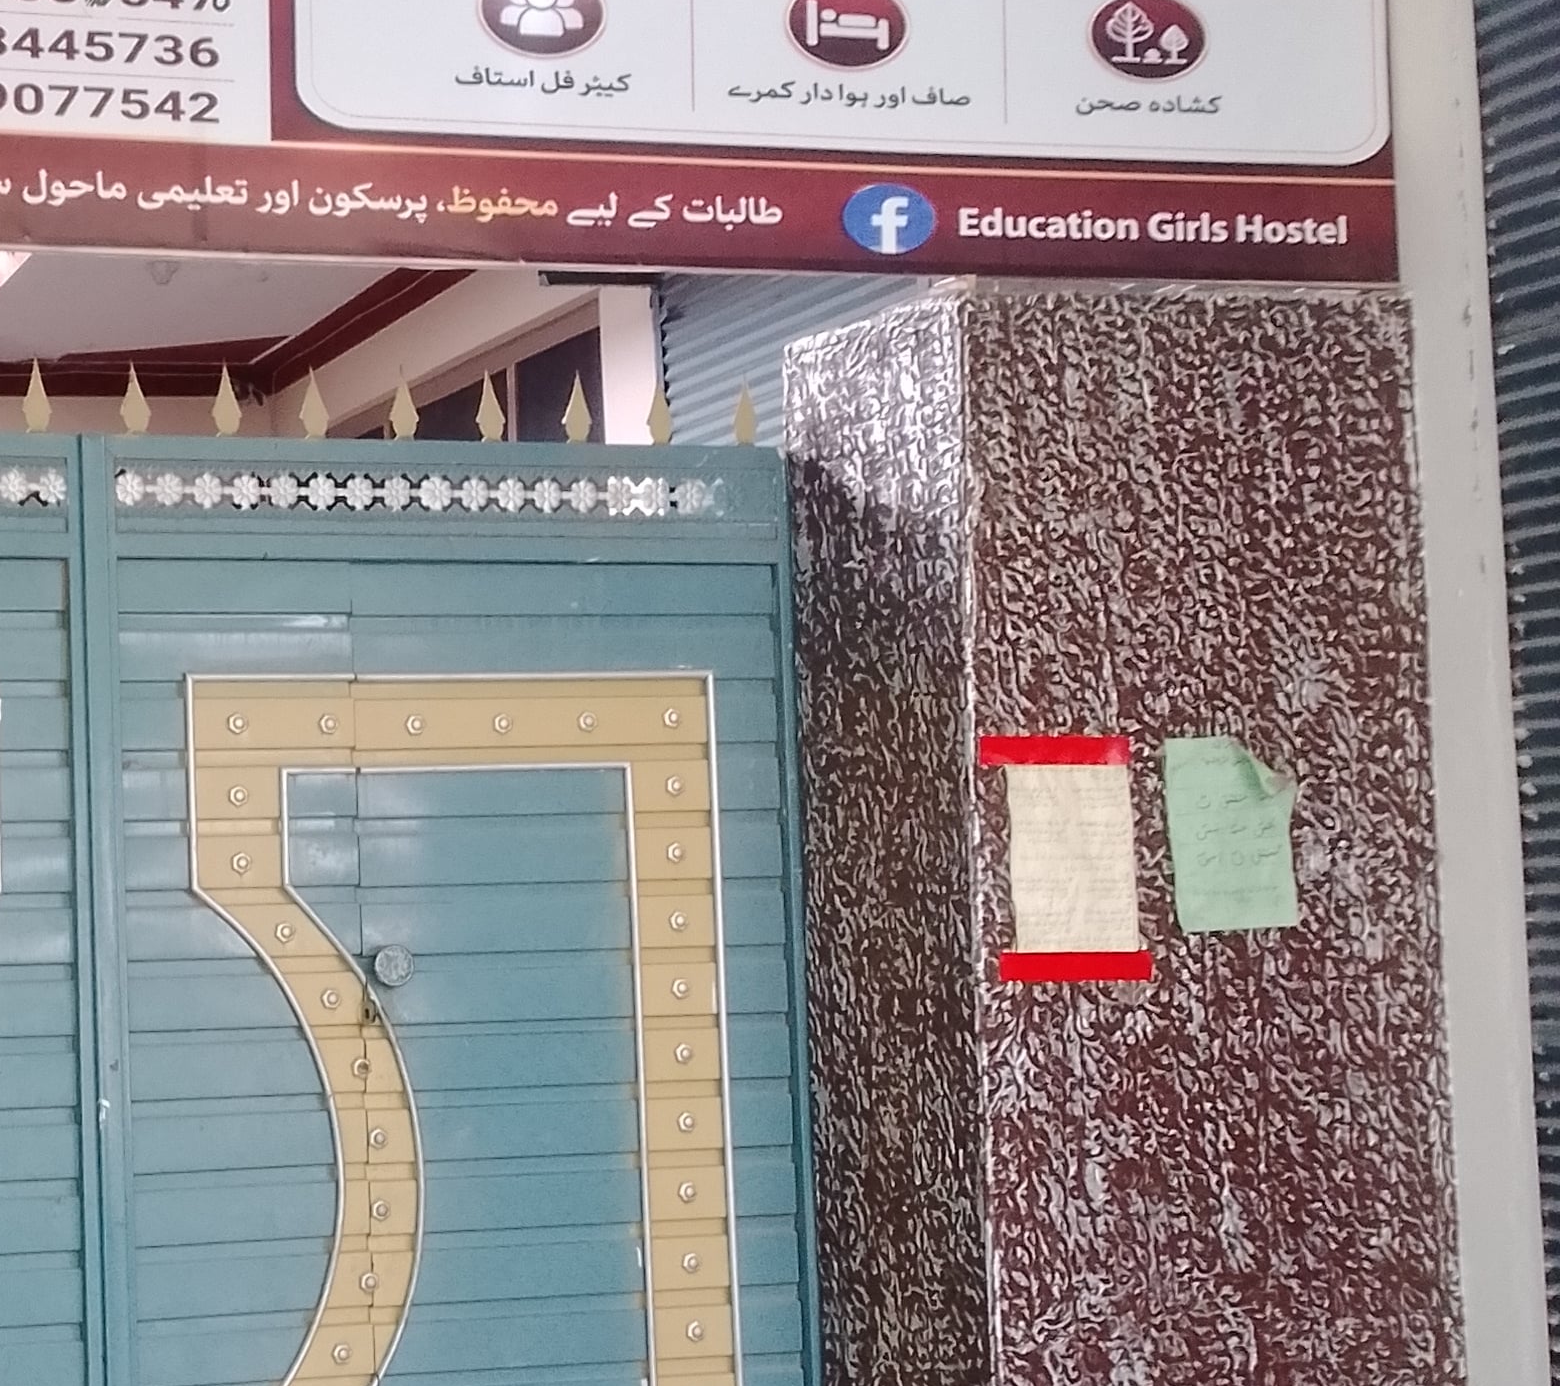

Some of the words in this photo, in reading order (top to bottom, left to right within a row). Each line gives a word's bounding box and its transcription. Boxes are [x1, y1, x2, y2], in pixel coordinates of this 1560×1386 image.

[540, 69, 576, 95] فل
[727, 79, 796, 104] کمرے
[799, 82, 834, 105] دار
[873, 86, 906, 109] اور
[911, 86, 972, 107] صاف
[1075, 94, 1141, 116] صحن
[1147, 93, 1223, 115] کشادہ
[22, 169, 128, 206] ماحول
[137, 175, 249, 212] تعلیمی
[257, 179, 300, 215] اور
[308, 183, 429, 225] پرسکون
[566, 192, 619, 229] لیے
[627, 193, 673, 229] کے
[683, 194, 785, 233] طالبات
[957, 206, 1140, 243] Education
[1147, 211, 1229, 246] Girls
[1235, 213, 1350, 247] Hostel
